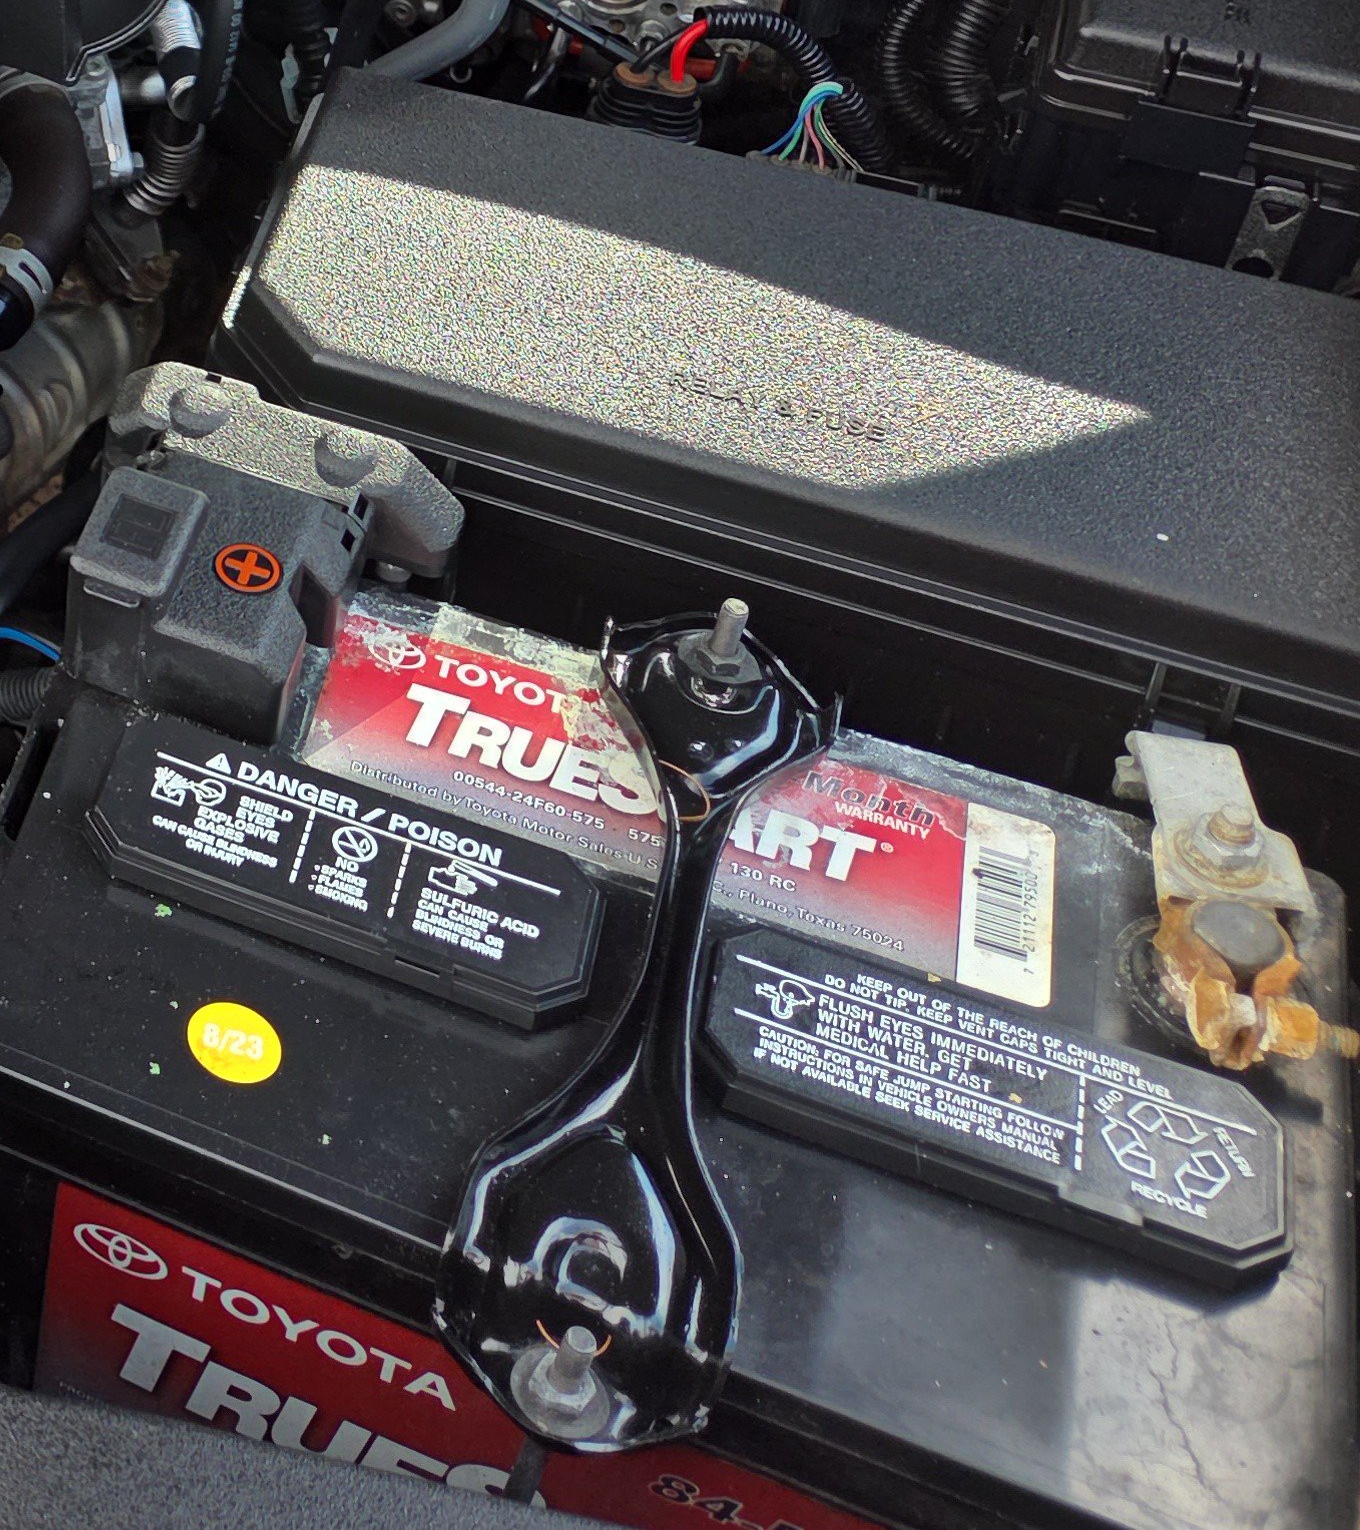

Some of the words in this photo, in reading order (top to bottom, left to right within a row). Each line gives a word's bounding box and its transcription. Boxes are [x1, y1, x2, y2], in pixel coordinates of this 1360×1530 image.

[668, 372, 767, 410] RELAY
[806, 408, 888, 443] FUSE
[434, 655, 608, 730] TOYOT
[197, 805, 281, 844] EXPLOSIVE
[235, 806, 276, 829] EYES
[237, 761, 359, 819] DANGER
[361, 808, 386, 823] /
[387, 813, 503, 867] POISON
[239, 795, 294, 822] SHIELD
[452, 770, 605, 830] 00544-24F60-575
[627, 827, 662, 848] 575
[802, 770, 936, 828] Month
[834, 800, 930, 840] WARRANTY
[152, 814, 178, 833] CAN
[177, 824, 216, 844] CAUSE
[215, 838, 278, 869] BLINDNESS
[193, 817, 245, 843] GASES
[350, 759, 438, 799] Distributed
[441, 789, 462, 806] by
[464, 797, 517, 826] Toyota
[521, 817, 574, 844] Motor
[738, 888, 793, 919] Plano,
[794, 906, 846, 933] Texas
[851, 923, 905, 952] 75024
[317, 874, 364, 898] FLAMES
[320, 864, 368, 889] SPARKS
[335, 856, 360, 873] NO
[730, 862, 763, 882] 130
[769, 874, 797, 893] RC
[314, 884, 369, 913] SMOKING
[417, 899, 444, 916] CAN
[447, 909, 489, 933] CAUSE
[420, 887, 499, 924] SULFURIC
[499, 916, 540, 939] ACID
[412, 919, 458, 945] SEVERE
[460, 936, 503, 961] BURNS
[415, 908, 481, 941] BLINDNESS
[484, 934, 505, 950] OR
[817, 1008, 861, 1034] WITH
[867, 1024, 930, 1058] WATER.
[937, 1050, 973, 1071] GET
[818, 993, 875, 1024] FLUSH
[879, 1014, 924, 1040] EYES
[930, 1031, 1048, 1081] IMMEDIATELY
[824, 974, 846, 989] DO
[850, 982, 880, 1000] NOT
[916, 1005, 953, 1024] KEEP
[957, 1019, 995, 1039] VENT
[999, 1033, 1039, 1055] CAPS
[1044, 1046, 1086, 1070] TIGHT
[1091, 1062, 1124, 1083] AND
[1128, 1076, 1175, 1102] LEVEL
[856, 973, 893, 993] KEEP
[896, 987, 927, 1005] OUT
[931, 998, 952, 1013] OF
[956, 1006, 984, 1025] THE
[989, 1018, 1038, 1042] REACH
[1042, 1035, 1063, 1050] OF
[1067, 1043, 1141, 1077] CHILDREN
[815, 1022, 889, 1060] MEDICAL
[896, 1050, 942, 1075] HELP
[947, 1067, 992, 1093] FAST
[753, 1046, 767, 1060] IF
[770, 1053, 799, 1071] NOT
[802, 1066, 872, 1099] AVAILABLE
[874, 1090, 910, 1113] SEEK
[913, 1103, 971, 1134] SERVICE
[975, 1126, 1061, 1165] ASSISTANCE
[759, 1037, 855, 1080] INSTRUCTIONS
[858, 1073, 873, 1087] IN
[877, 1079, 932, 1108] VEHICLE
[936, 1100, 996, 1130] OWNERS
[1001, 1122, 1059, 1152] MANUAL
[823, 1049, 851, 1067] FOR
[855, 1060, 890, 1081] SAFE
[892, 1074, 931, 1093] JUMP
[934, 1087, 1003, 1119] STARTING
[1007, 1111, 1066, 1140] FOLLOW
[1093, 1089, 1124, 1115] LEAD
[1212, 1126, 1256, 1178] RETURN
[1130, 1180, 1208, 1220] RECYCLE
[181, 1265, 457, 1412] TOYOTA
